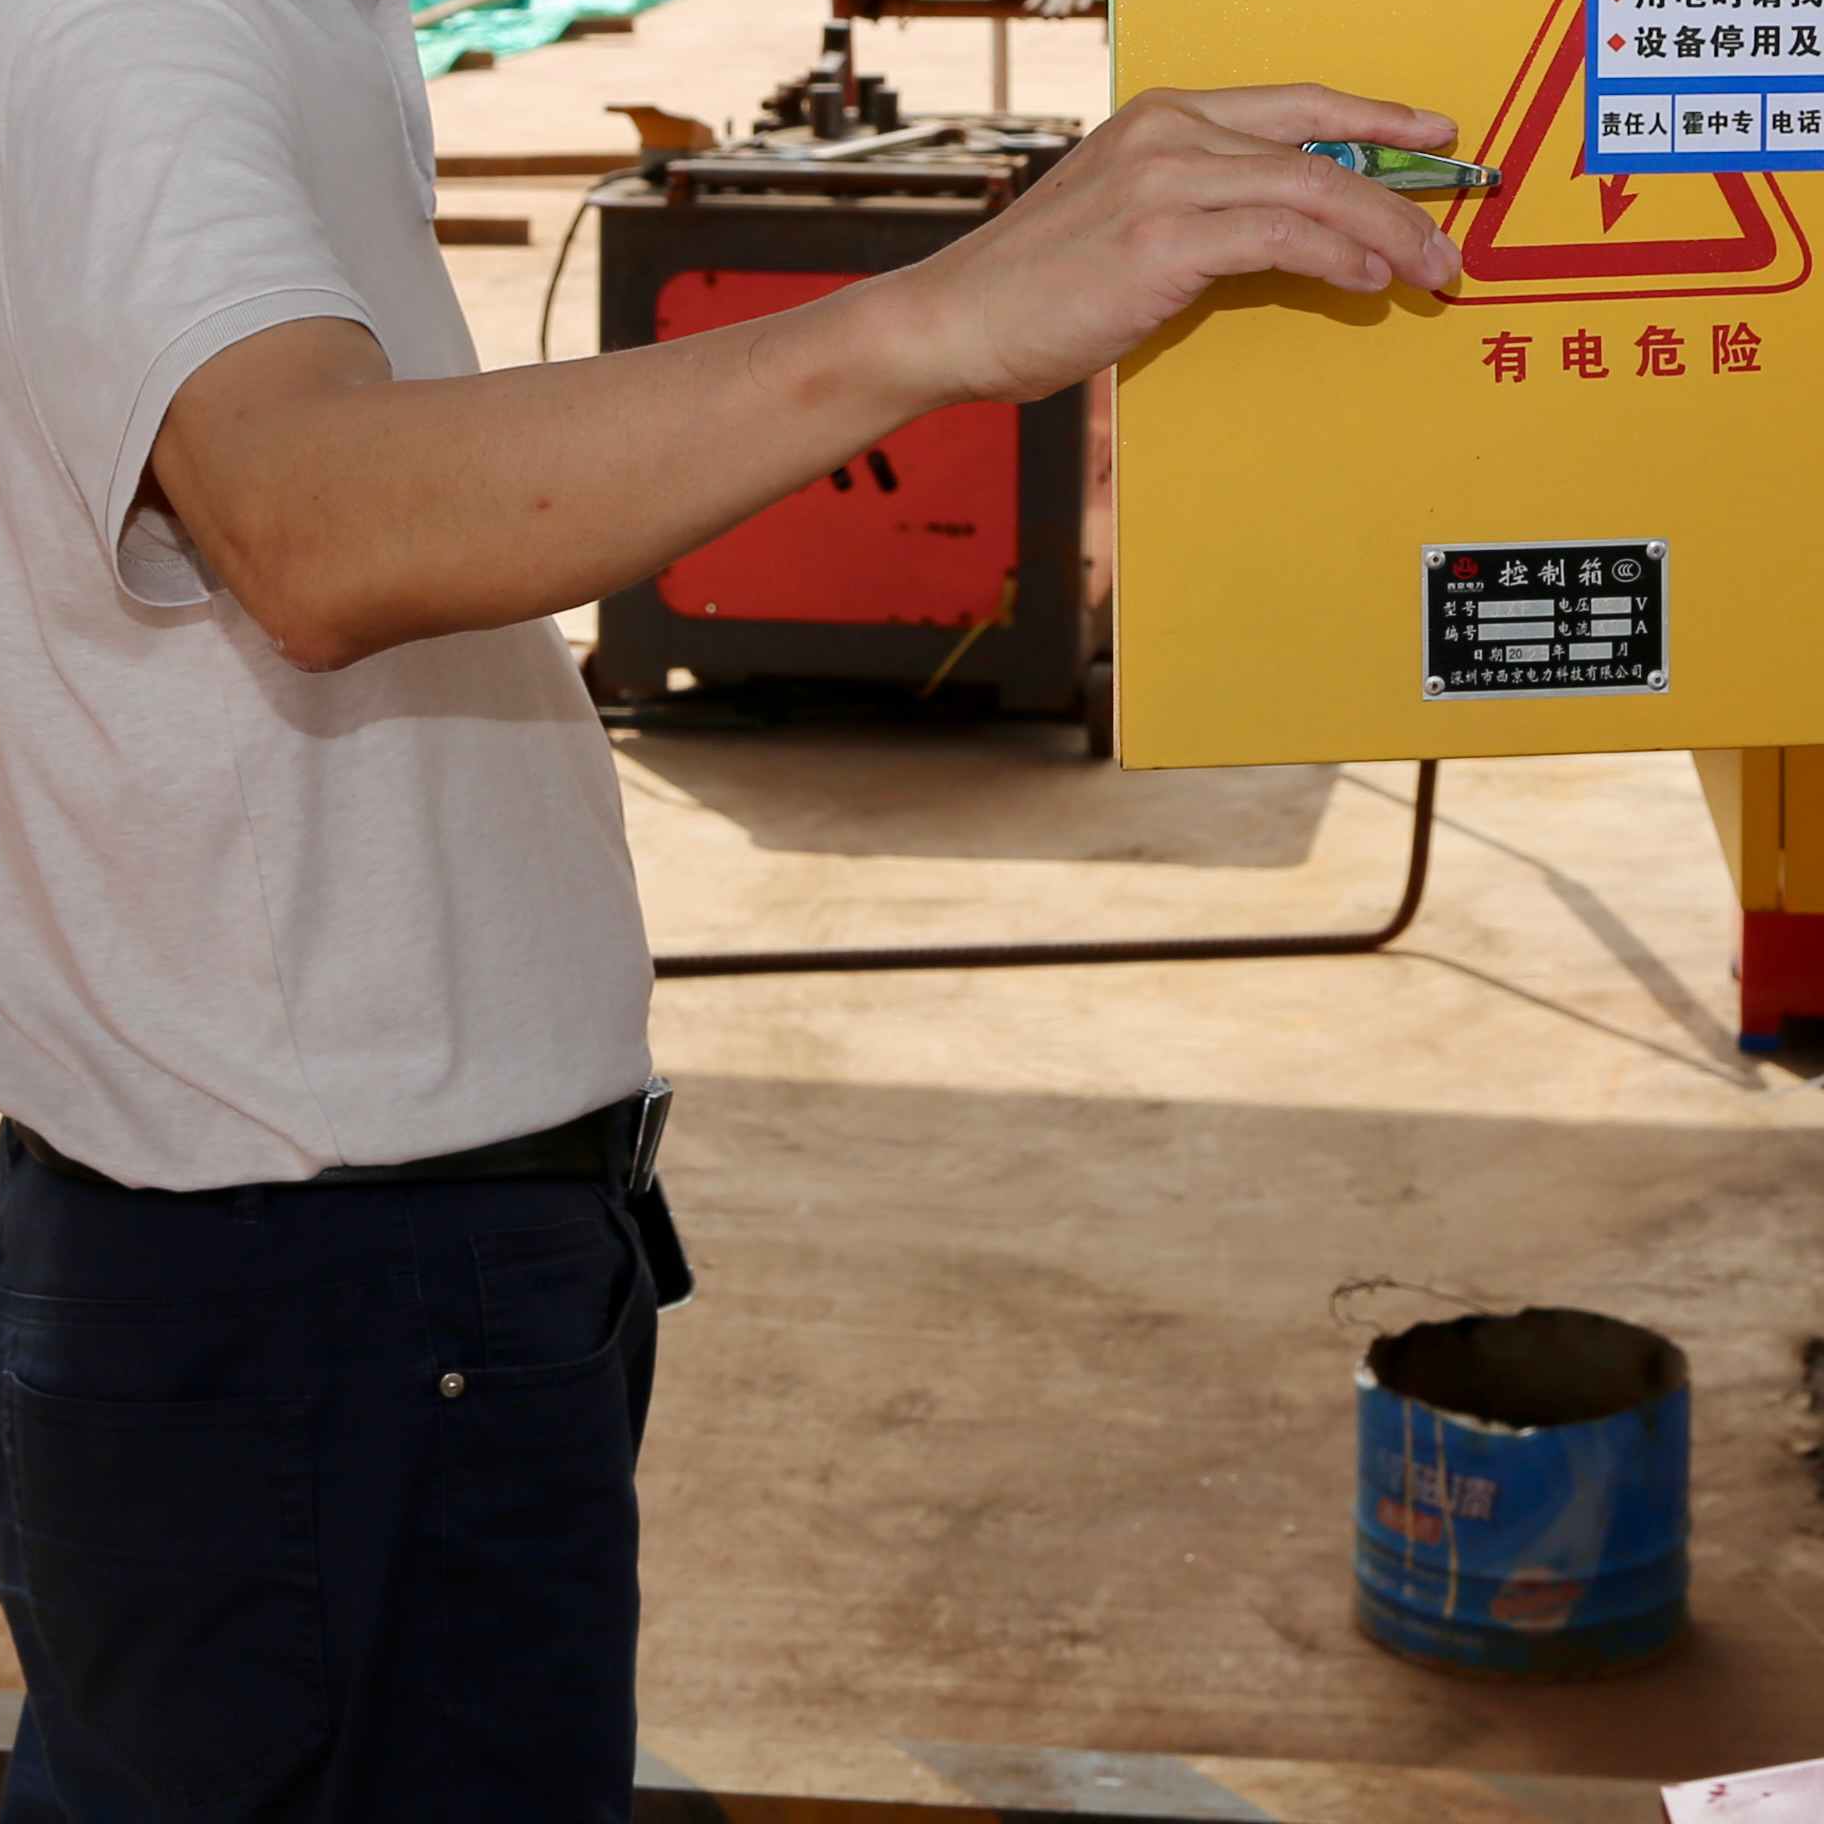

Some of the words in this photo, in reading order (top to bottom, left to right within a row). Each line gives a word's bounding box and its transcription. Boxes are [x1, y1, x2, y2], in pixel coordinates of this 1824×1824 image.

[1601, 110, 1668, 137] 责任人
[1682, 110, 1754, 135] 霍中专
[1772, 110, 1822, 134] 电话
[1481, 322, 1763, 383] 有电危险
[1498, 557, 1603, 587] 控制箱
[1443, 600, 1476, 617] 型号
[1558, 597, 1590, 613] 电压
[1636, 597, 1648, 611] V
[1444, 625, 1476, 642] 编号
[1558, 620, 1591, 637] 电流
[1635, 620, 1649, 634] A
[1474, 647, 1503, 662] 日期
[1552, 644, 1566, 661] 年
[1616, 642, 1629, 657] 月
